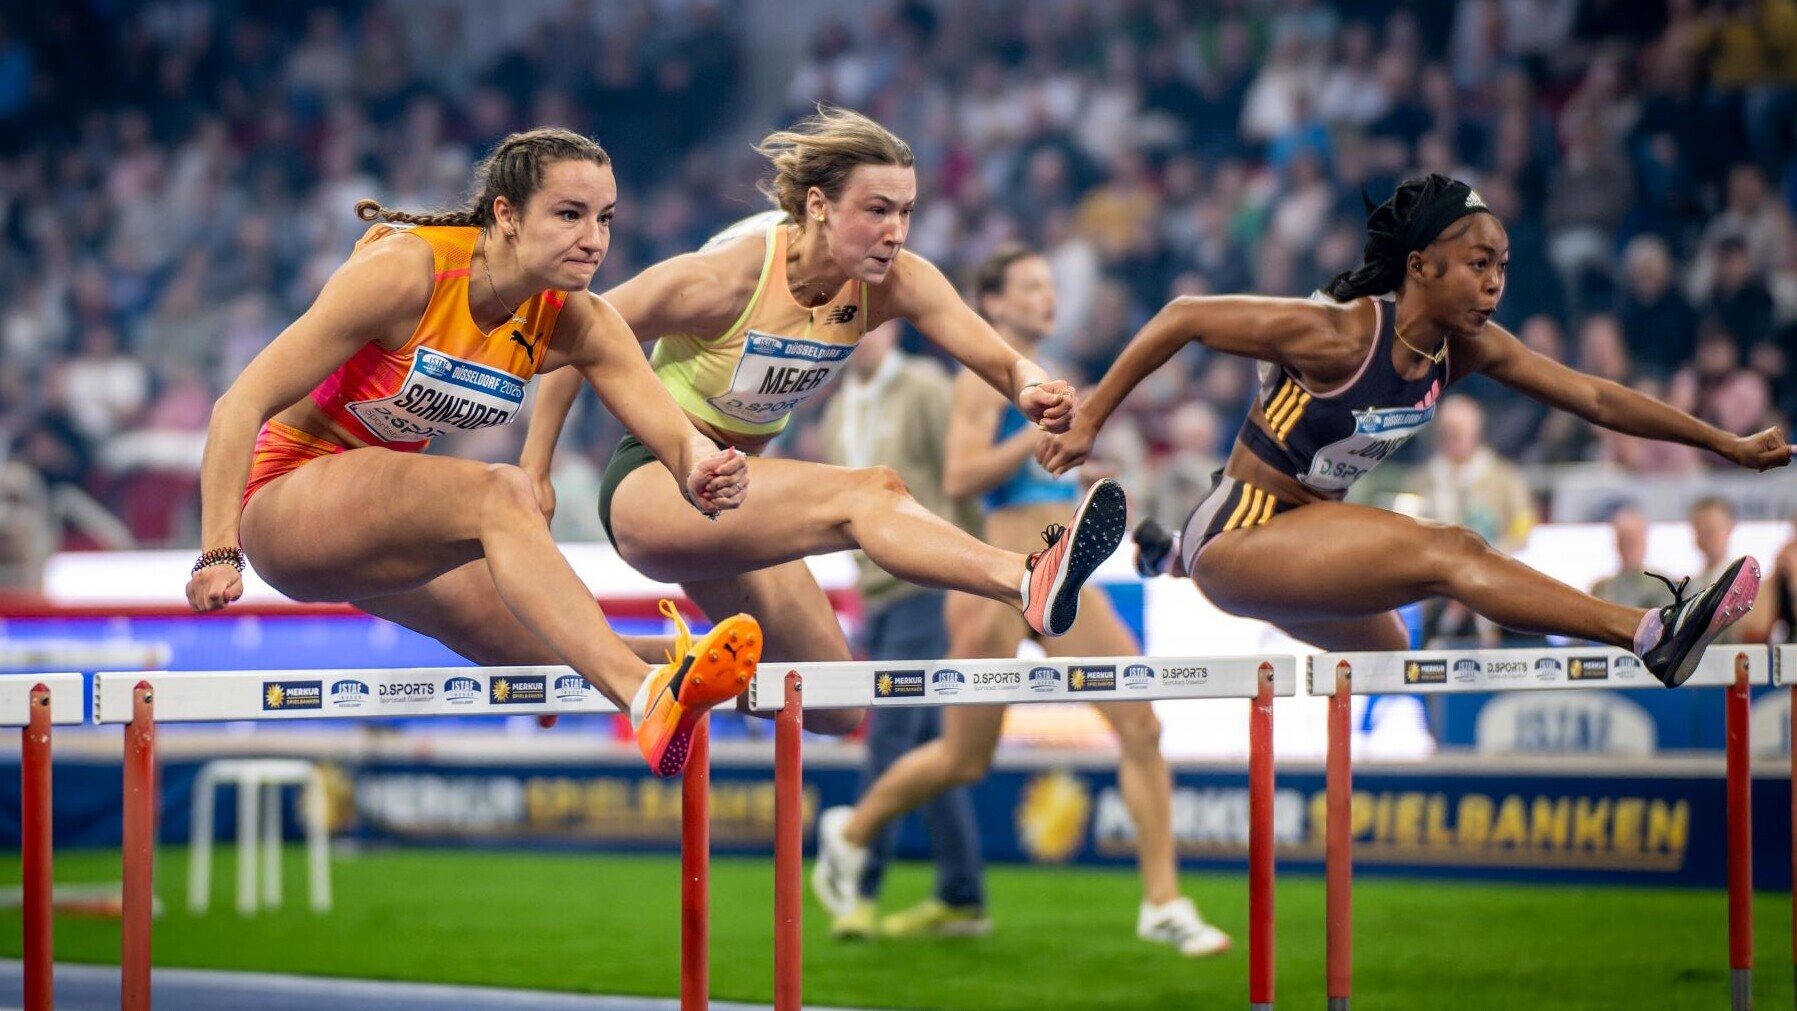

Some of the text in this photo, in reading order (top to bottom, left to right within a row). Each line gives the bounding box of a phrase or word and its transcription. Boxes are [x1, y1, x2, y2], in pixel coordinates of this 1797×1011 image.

[451, 365, 501, 390] DÜSSELDORF
[500, 380, 522, 398] 2025
[758, 365, 830, 395] MEIER
[1129, 667, 1149, 677] ISTAF
[1487, 662, 1528, 673] D.SPORTS
[938, 672, 959, 682] ISTAF
[973, 672, 1021, 684] D.SPORTS
[1034, 670, 1055, 679] ISTAF
[1086, 671, 1114, 679] MERKUR
[1162, 668, 1208, 679] D.SPORTS
[451, 680, 475, 690] ISTAF
[561, 678, 584, 688] ISTAF
[894, 676, 923, 684] MERKUR
[286, 687, 320, 696] MERKUR
[338, 682, 362, 693] ISTAF
[379, 683, 435, 696] D.SPORTS
